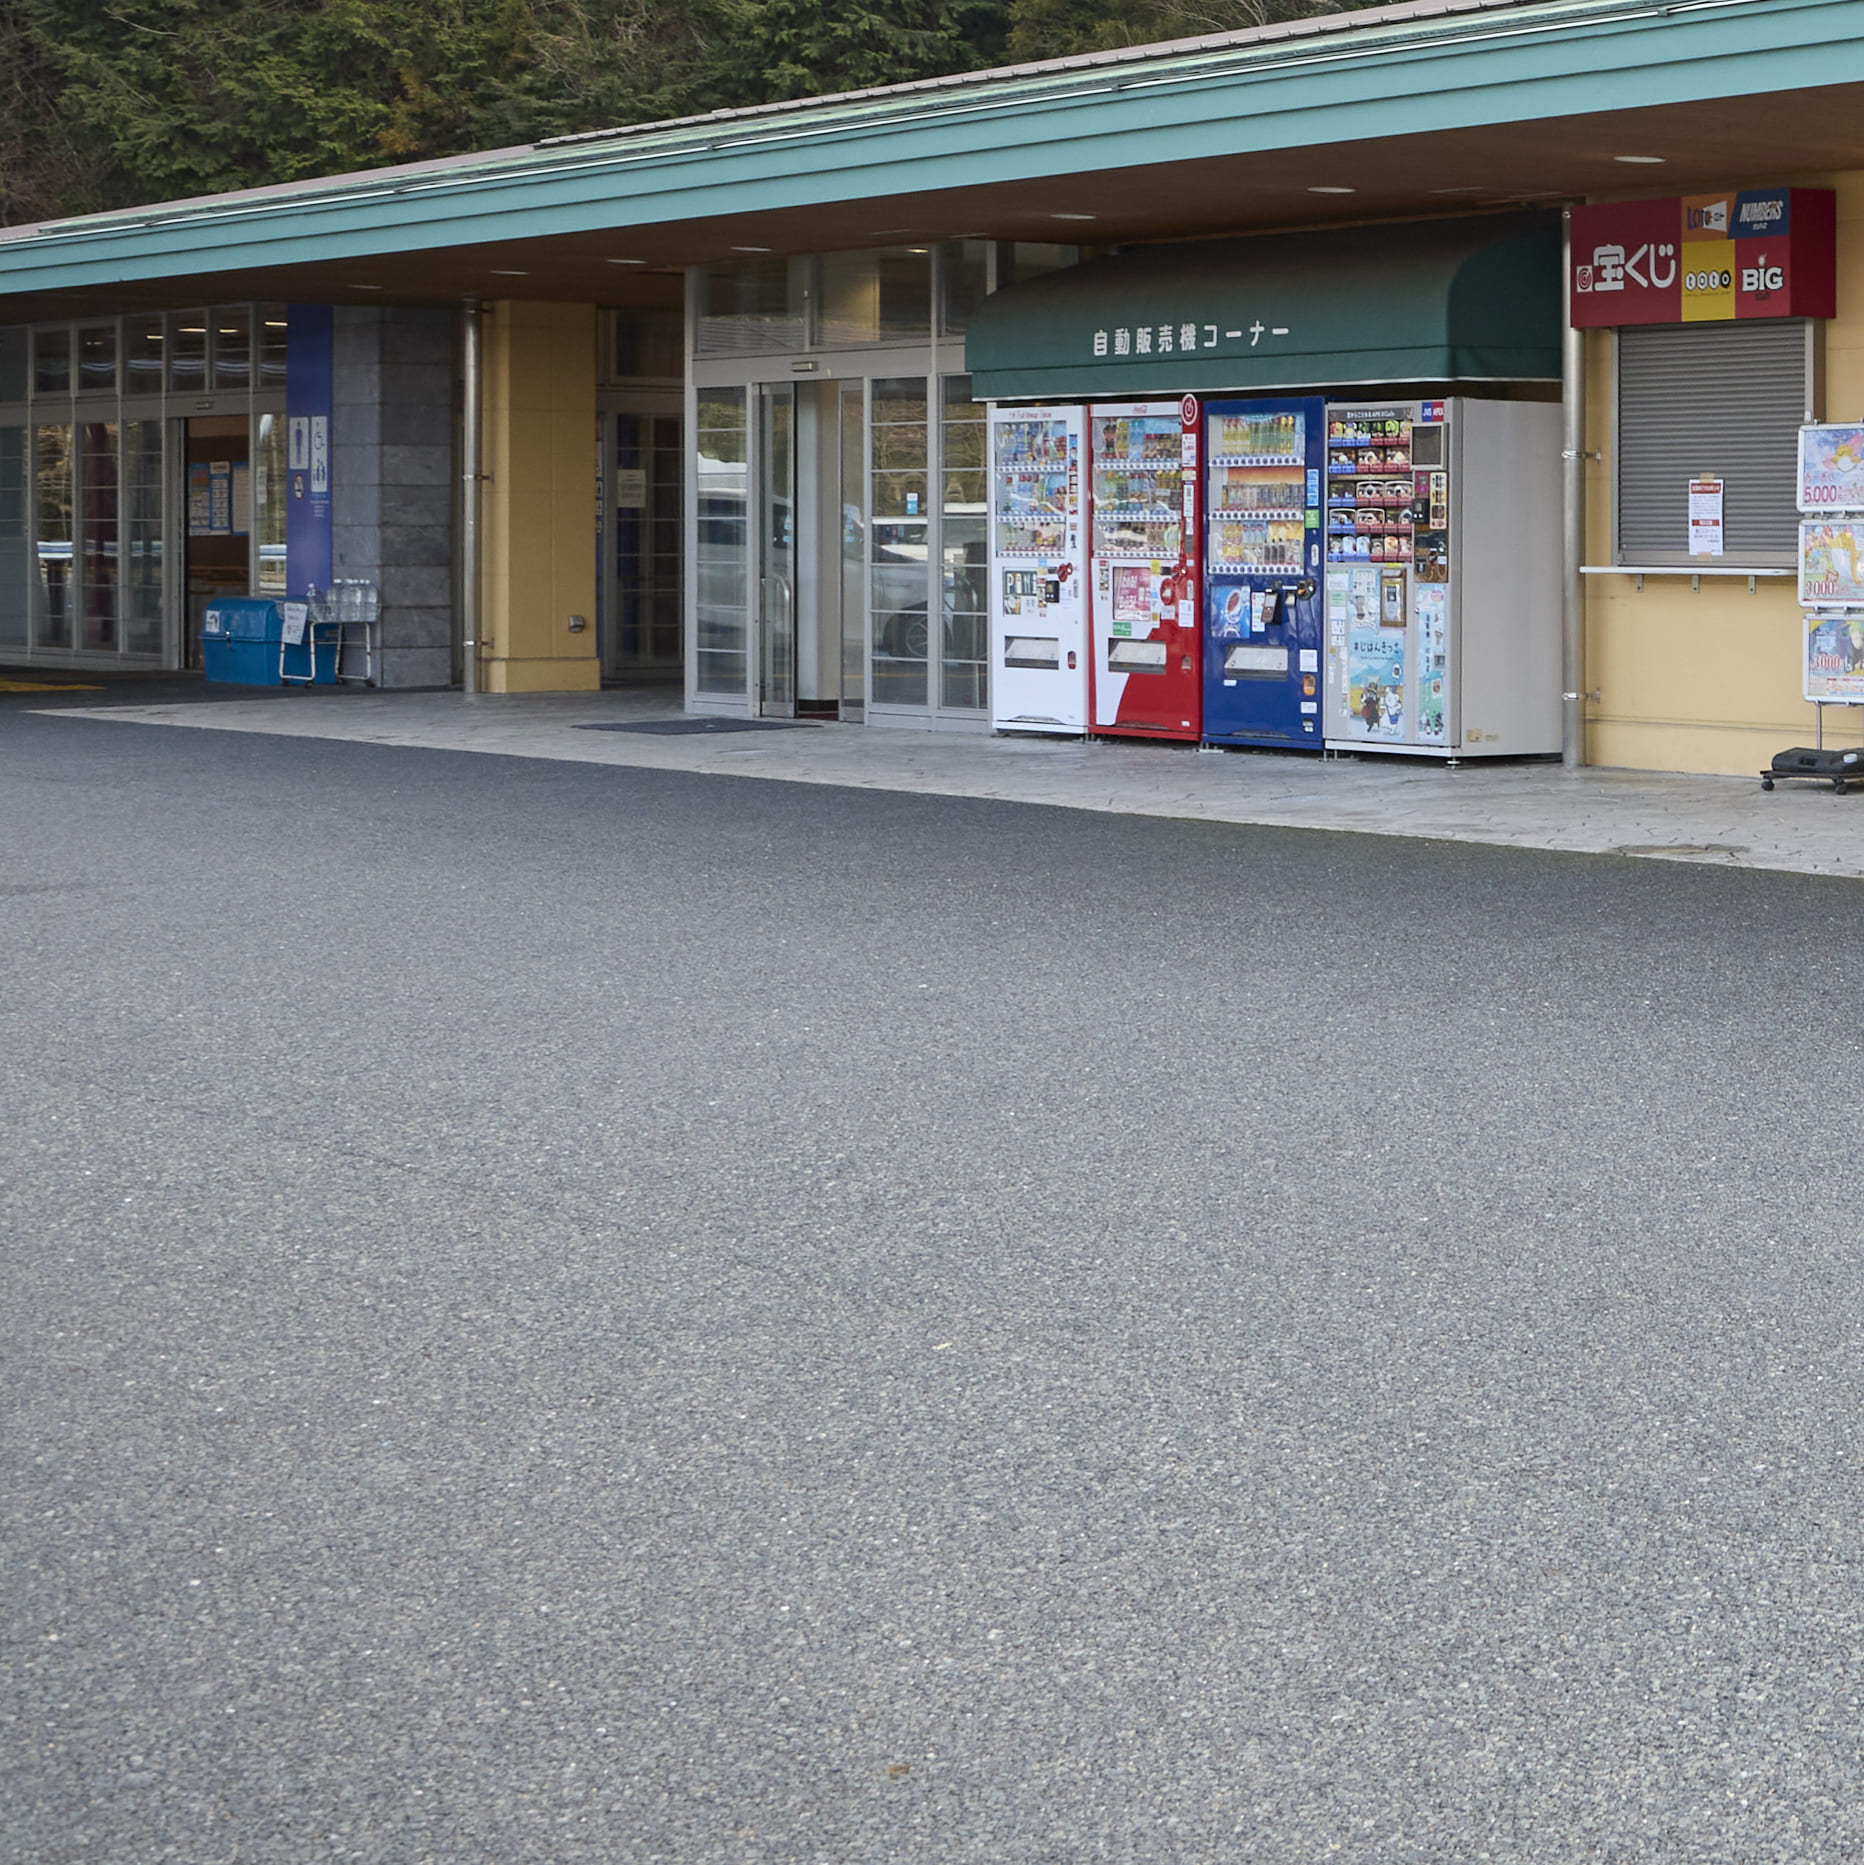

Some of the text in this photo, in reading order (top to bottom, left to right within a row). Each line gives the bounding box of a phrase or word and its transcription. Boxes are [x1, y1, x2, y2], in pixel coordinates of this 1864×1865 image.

[1739, 200, 1784, 223] NUMBERS
[1593, 243, 1676, 292] 宝くじ
[1685, 269, 1732, 291] toto
[1742, 266, 1784, 292] BIG
[1093, 319, 1290, 357] 自動販売機コーナー
